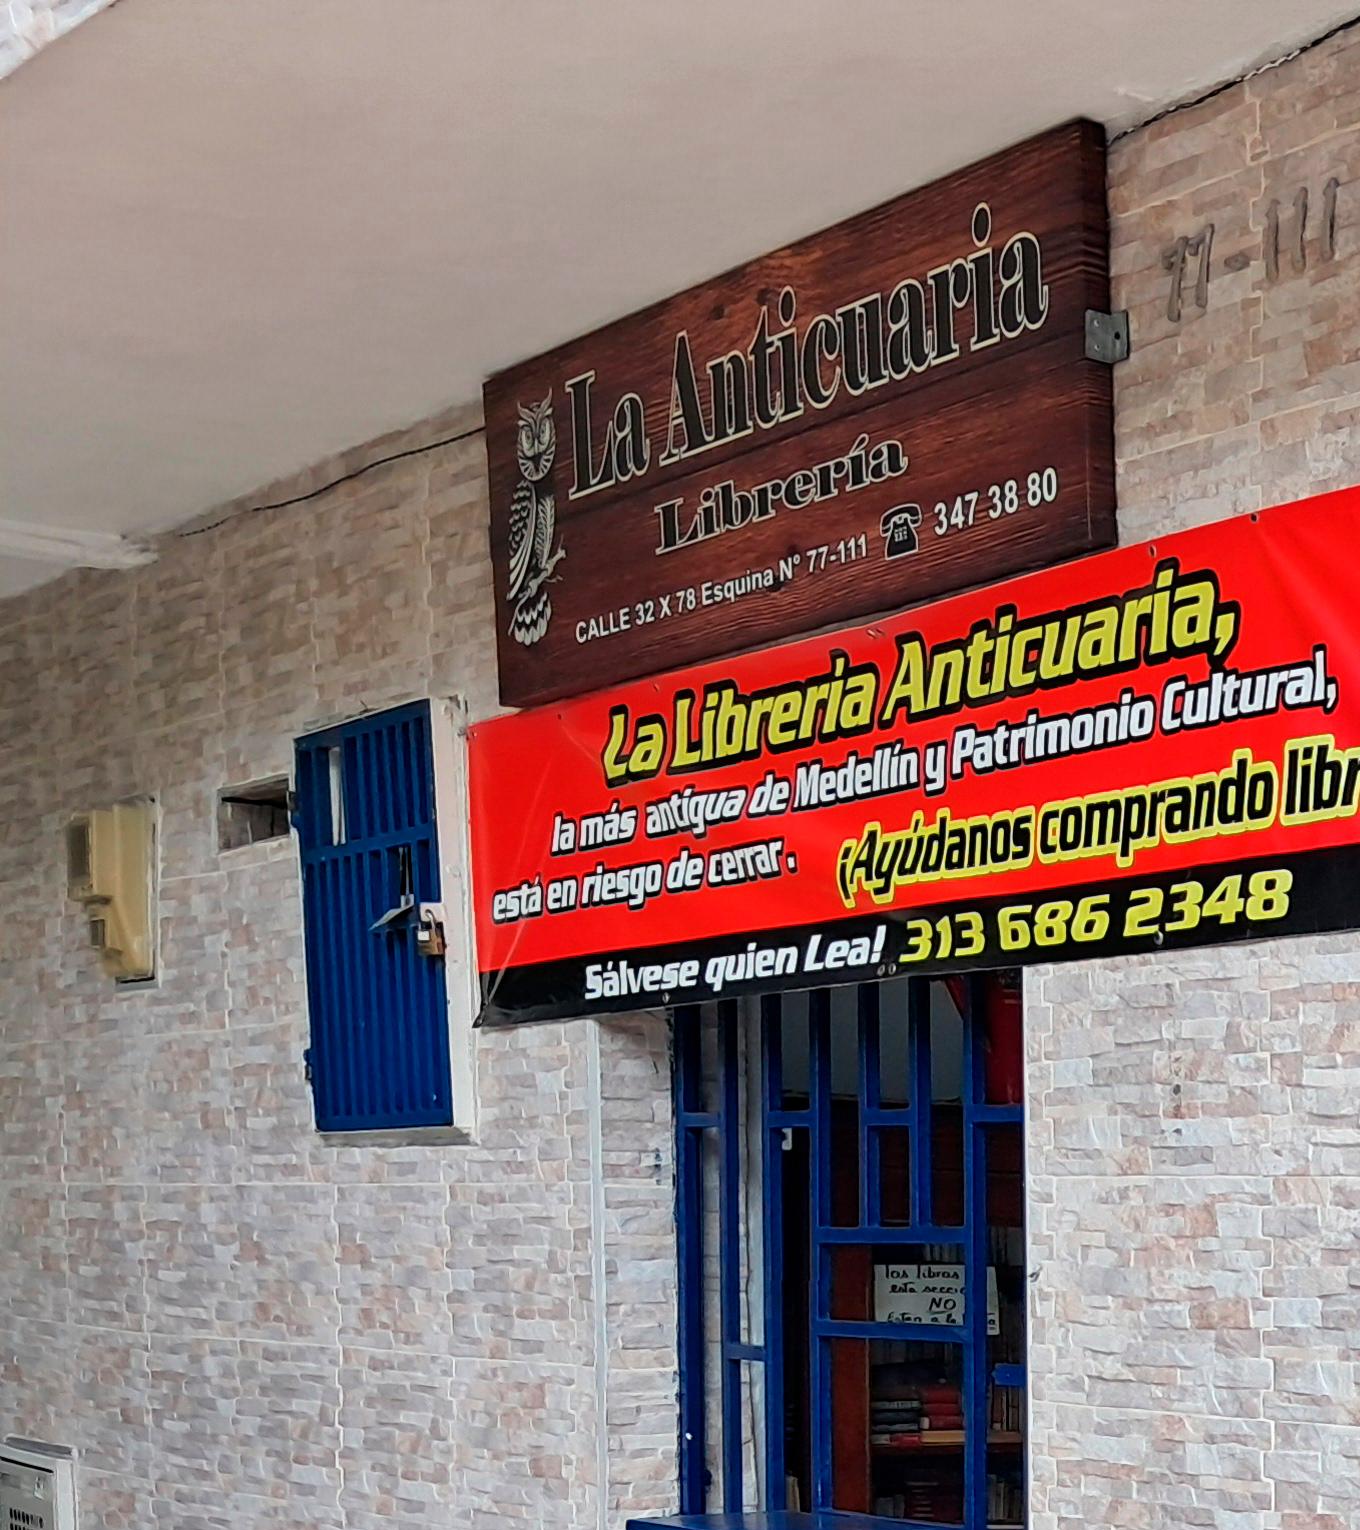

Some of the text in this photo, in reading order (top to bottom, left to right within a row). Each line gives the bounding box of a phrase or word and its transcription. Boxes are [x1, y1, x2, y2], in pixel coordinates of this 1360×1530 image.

[565, 202, 1049, 499] La Anticuaria
[655, 433, 909, 555] Librería
[933, 467, 1058, 537] 347 38 80
[575, 607, 632, 644] CALLE
[634, 597, 656, 626] 32
[659, 595, 672, 618] X
[675, 588, 697, 614] 78
[701, 567, 774, 606] Esquina
[805, 534, 868, 574] 77-111
[604, 715, 663, 778] La
[883, 567, 1236, 720] Anticuaria,
[551, 815, 575, 851] la
[580, 803, 637, 847] más
[748, 774, 790, 813] de
[794, 742, 918, 807] Medellín
[925, 747, 945, 792] y
[952, 694, 1154, 770] Patrimonio
[1162, 650, 1338, 728] Cultural,
[838, 812, 1035, 902] ¡Ayúdanos
[1040, 755, 1275, 858] comprando
[493, 877, 541, 920] está
[547, 880, 576, 910] en
[582, 866, 662, 905] riesgo
[666, 851, 703, 889] de
[899, 869, 1293, 963] 313 686 2348
[585, 925, 885, 1000] Sálvese quien Lea!
[917, 1264, 960, 1280] libros
[928, 1297, 957, 1312] NO
